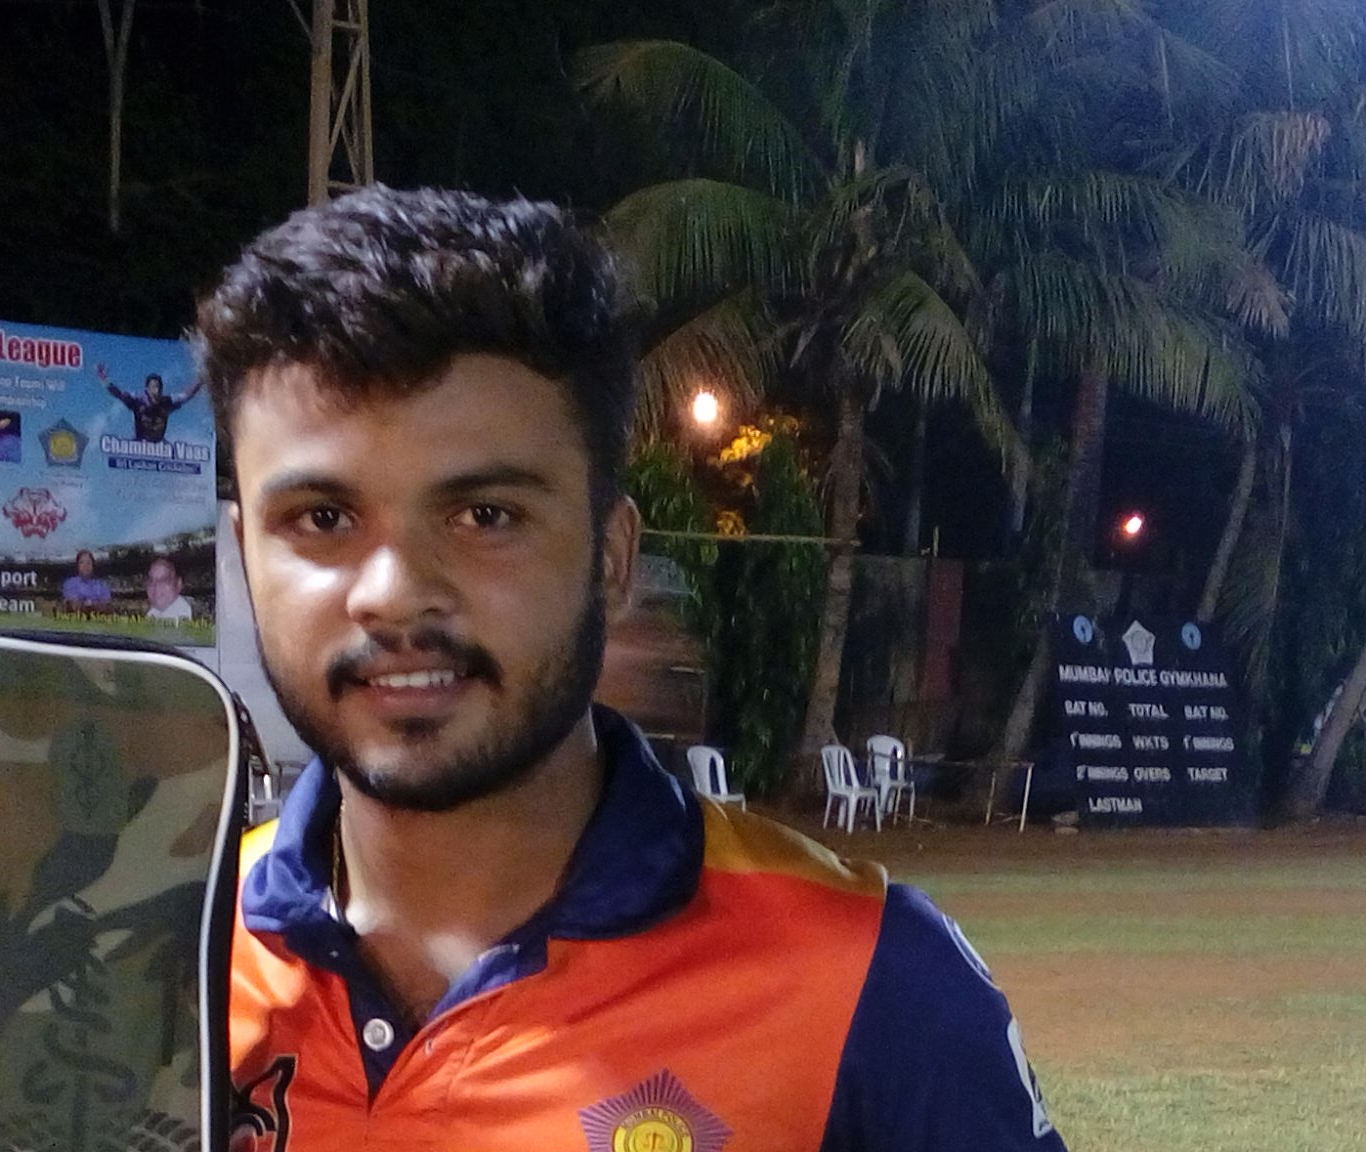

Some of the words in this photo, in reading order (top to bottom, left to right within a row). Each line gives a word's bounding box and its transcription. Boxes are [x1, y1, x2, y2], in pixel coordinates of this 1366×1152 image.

[101, 434, 172, 459] Chaminda
[1058, 664, 1110, 684] MUMBAI
[1114, 666, 1158, 687] POLICE
[1160, 670, 1228, 688] GYMKHANA
[1129, 703, 1169, 719] TOTAL
